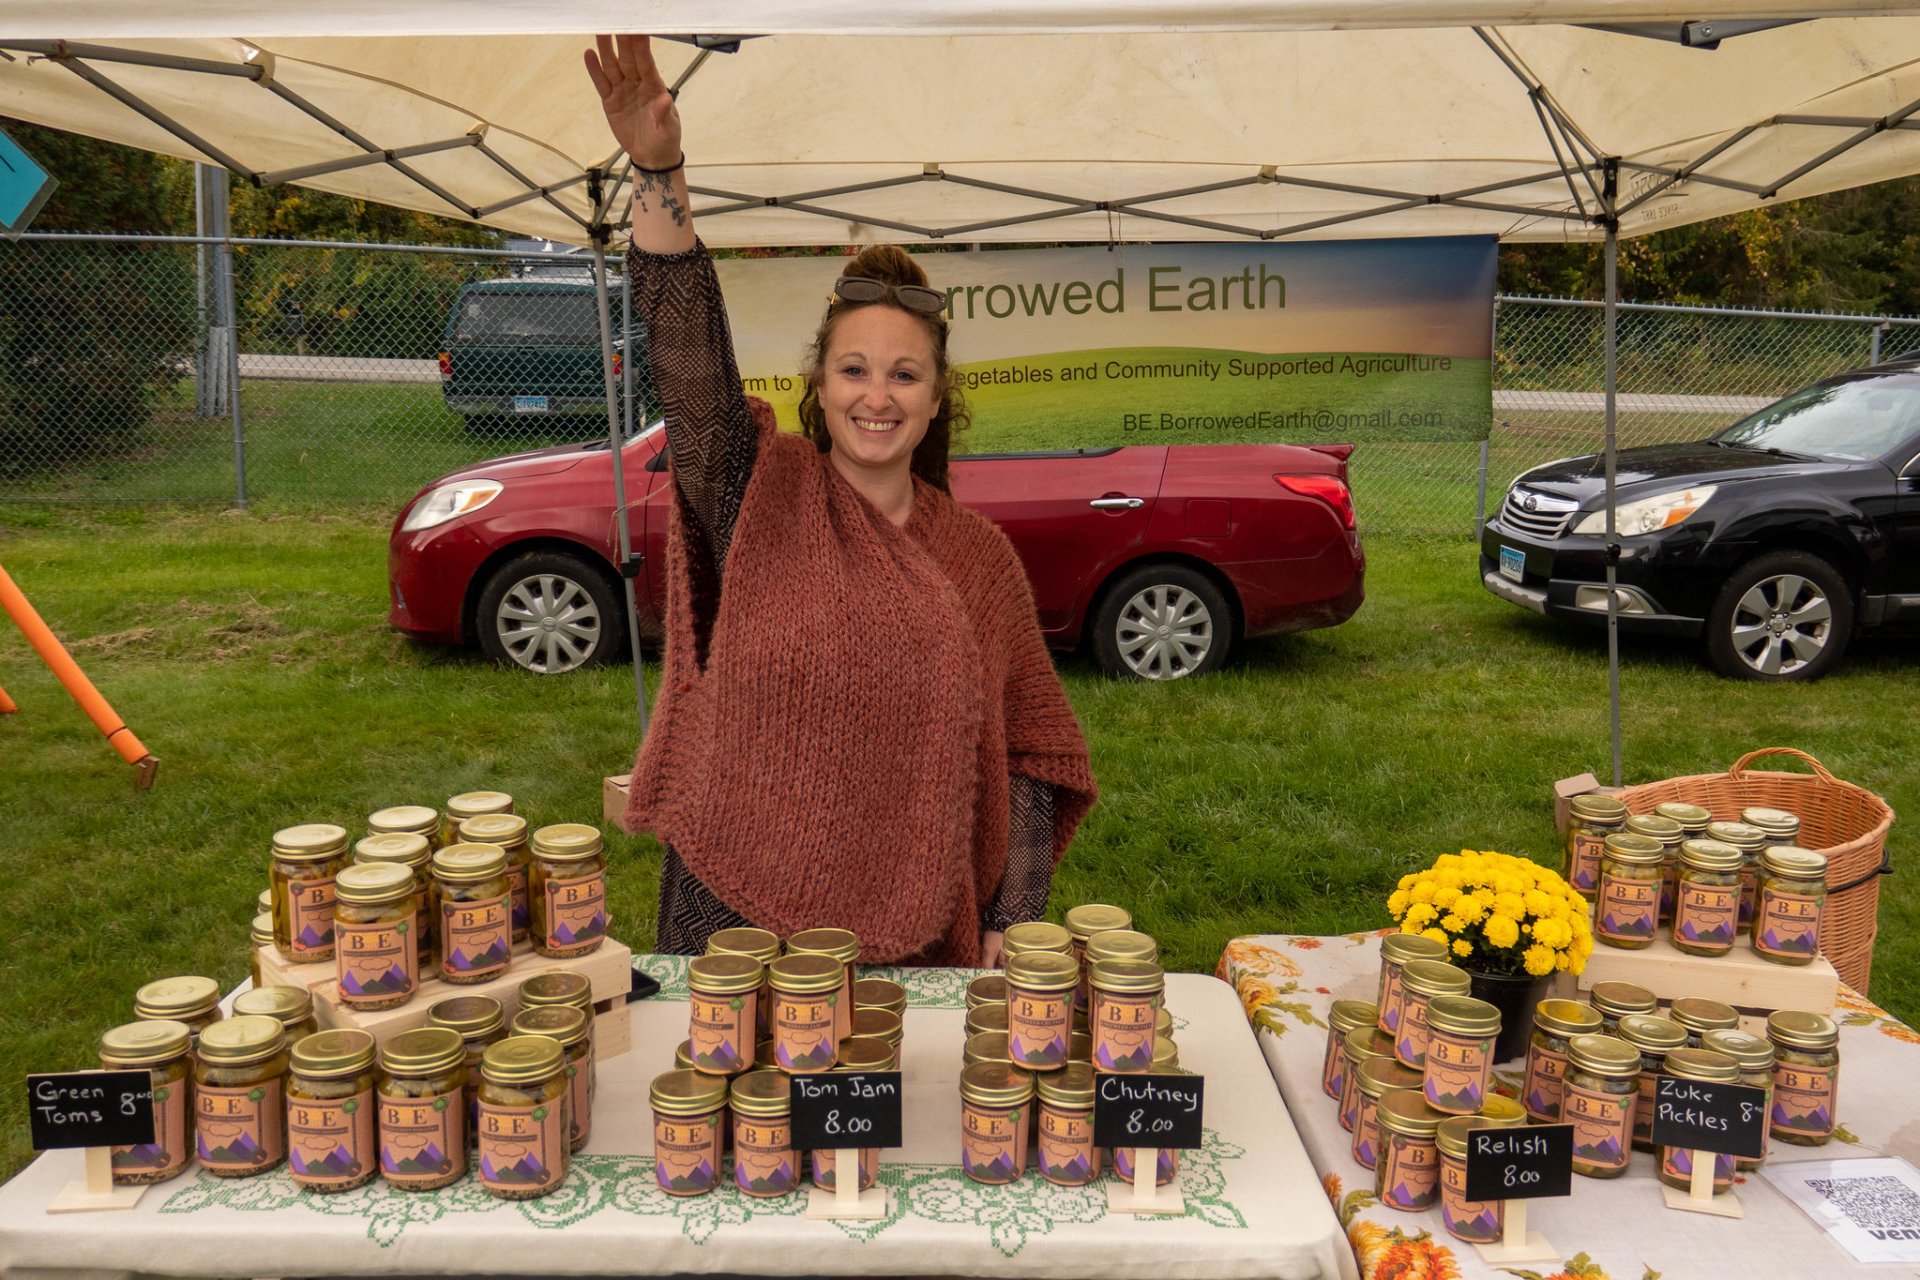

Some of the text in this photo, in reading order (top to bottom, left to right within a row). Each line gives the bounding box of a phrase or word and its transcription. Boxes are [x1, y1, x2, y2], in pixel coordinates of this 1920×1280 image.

[945, 263, 1286, 320] rrowed Earth
[742, 378, 767, 391] rm
[773, 374, 792, 391] to
[957, 365, 1053, 390] egetables
[1060, 362, 1097, 381] and
[1105, 360, 1221, 381] Community
[1228, 356, 1334, 380] Supported
[1339, 354, 1452, 378] Agriculture
[1124, 409, 1443, 433] BE.BorrowedEarth@gmail.com
[1589, 845, 1599, 856] B
[312, 889, 324, 903] B
[566, 889, 578, 902] B
[588, 883, 598, 897] E
[1616, 886, 1647, 900] B E
[1695, 893, 1727, 907] B E
[462, 912, 475, 927] B
[486, 908, 498, 923] E
[1777, 901, 1811, 916] B E
[351, 933, 392, 949] B E
[692, 1000, 724, 1022] B E
[785, 1006, 823, 1021] B E
[1021, 1001, 1058, 1018] B E
[1110, 1006, 1146, 1022] B E
[1437, 1043, 1448, 1059] B
[1461, 1049, 1473, 1064] E
[1544, 1060, 1556, 1074] B
[794, 1076, 895, 1097] Tom Jam
[1786, 1072, 1821, 1089] B E
[36, 1081, 104, 1100] Green
[1101, 1078, 1197, 1112] Chutney
[1660, 1080, 1713, 1102] Zuke
[36, 1105, 103, 1124] Toms
[202, 1097, 242, 1114] B E
[1576, 1097, 1588, 1112] B
[1600, 1104, 1612, 1118] E
[297, 1110, 337, 1126] B E
[388, 1108, 427, 1125] B E
[487, 1117, 526, 1134] B E
[825, 1109, 872, 1134] 8.00
[968, 1114, 978, 1131] B
[990, 1120, 1002, 1135] E
[1126, 1109, 1173, 1134] 8.00
[1658, 1102, 1728, 1131] Pickles
[664, 1126, 702, 1143] B E
[1045, 1116, 1079, 1136] B E
[745, 1127, 783, 1145] B E
[1475, 1135, 1548, 1155] Relish
[1412, 1149, 1424, 1163] B
[1447, 1169, 1458, 1185] B
[1504, 1164, 1540, 1187] 8.00
[1867, 1229, 1920, 1241] ven
